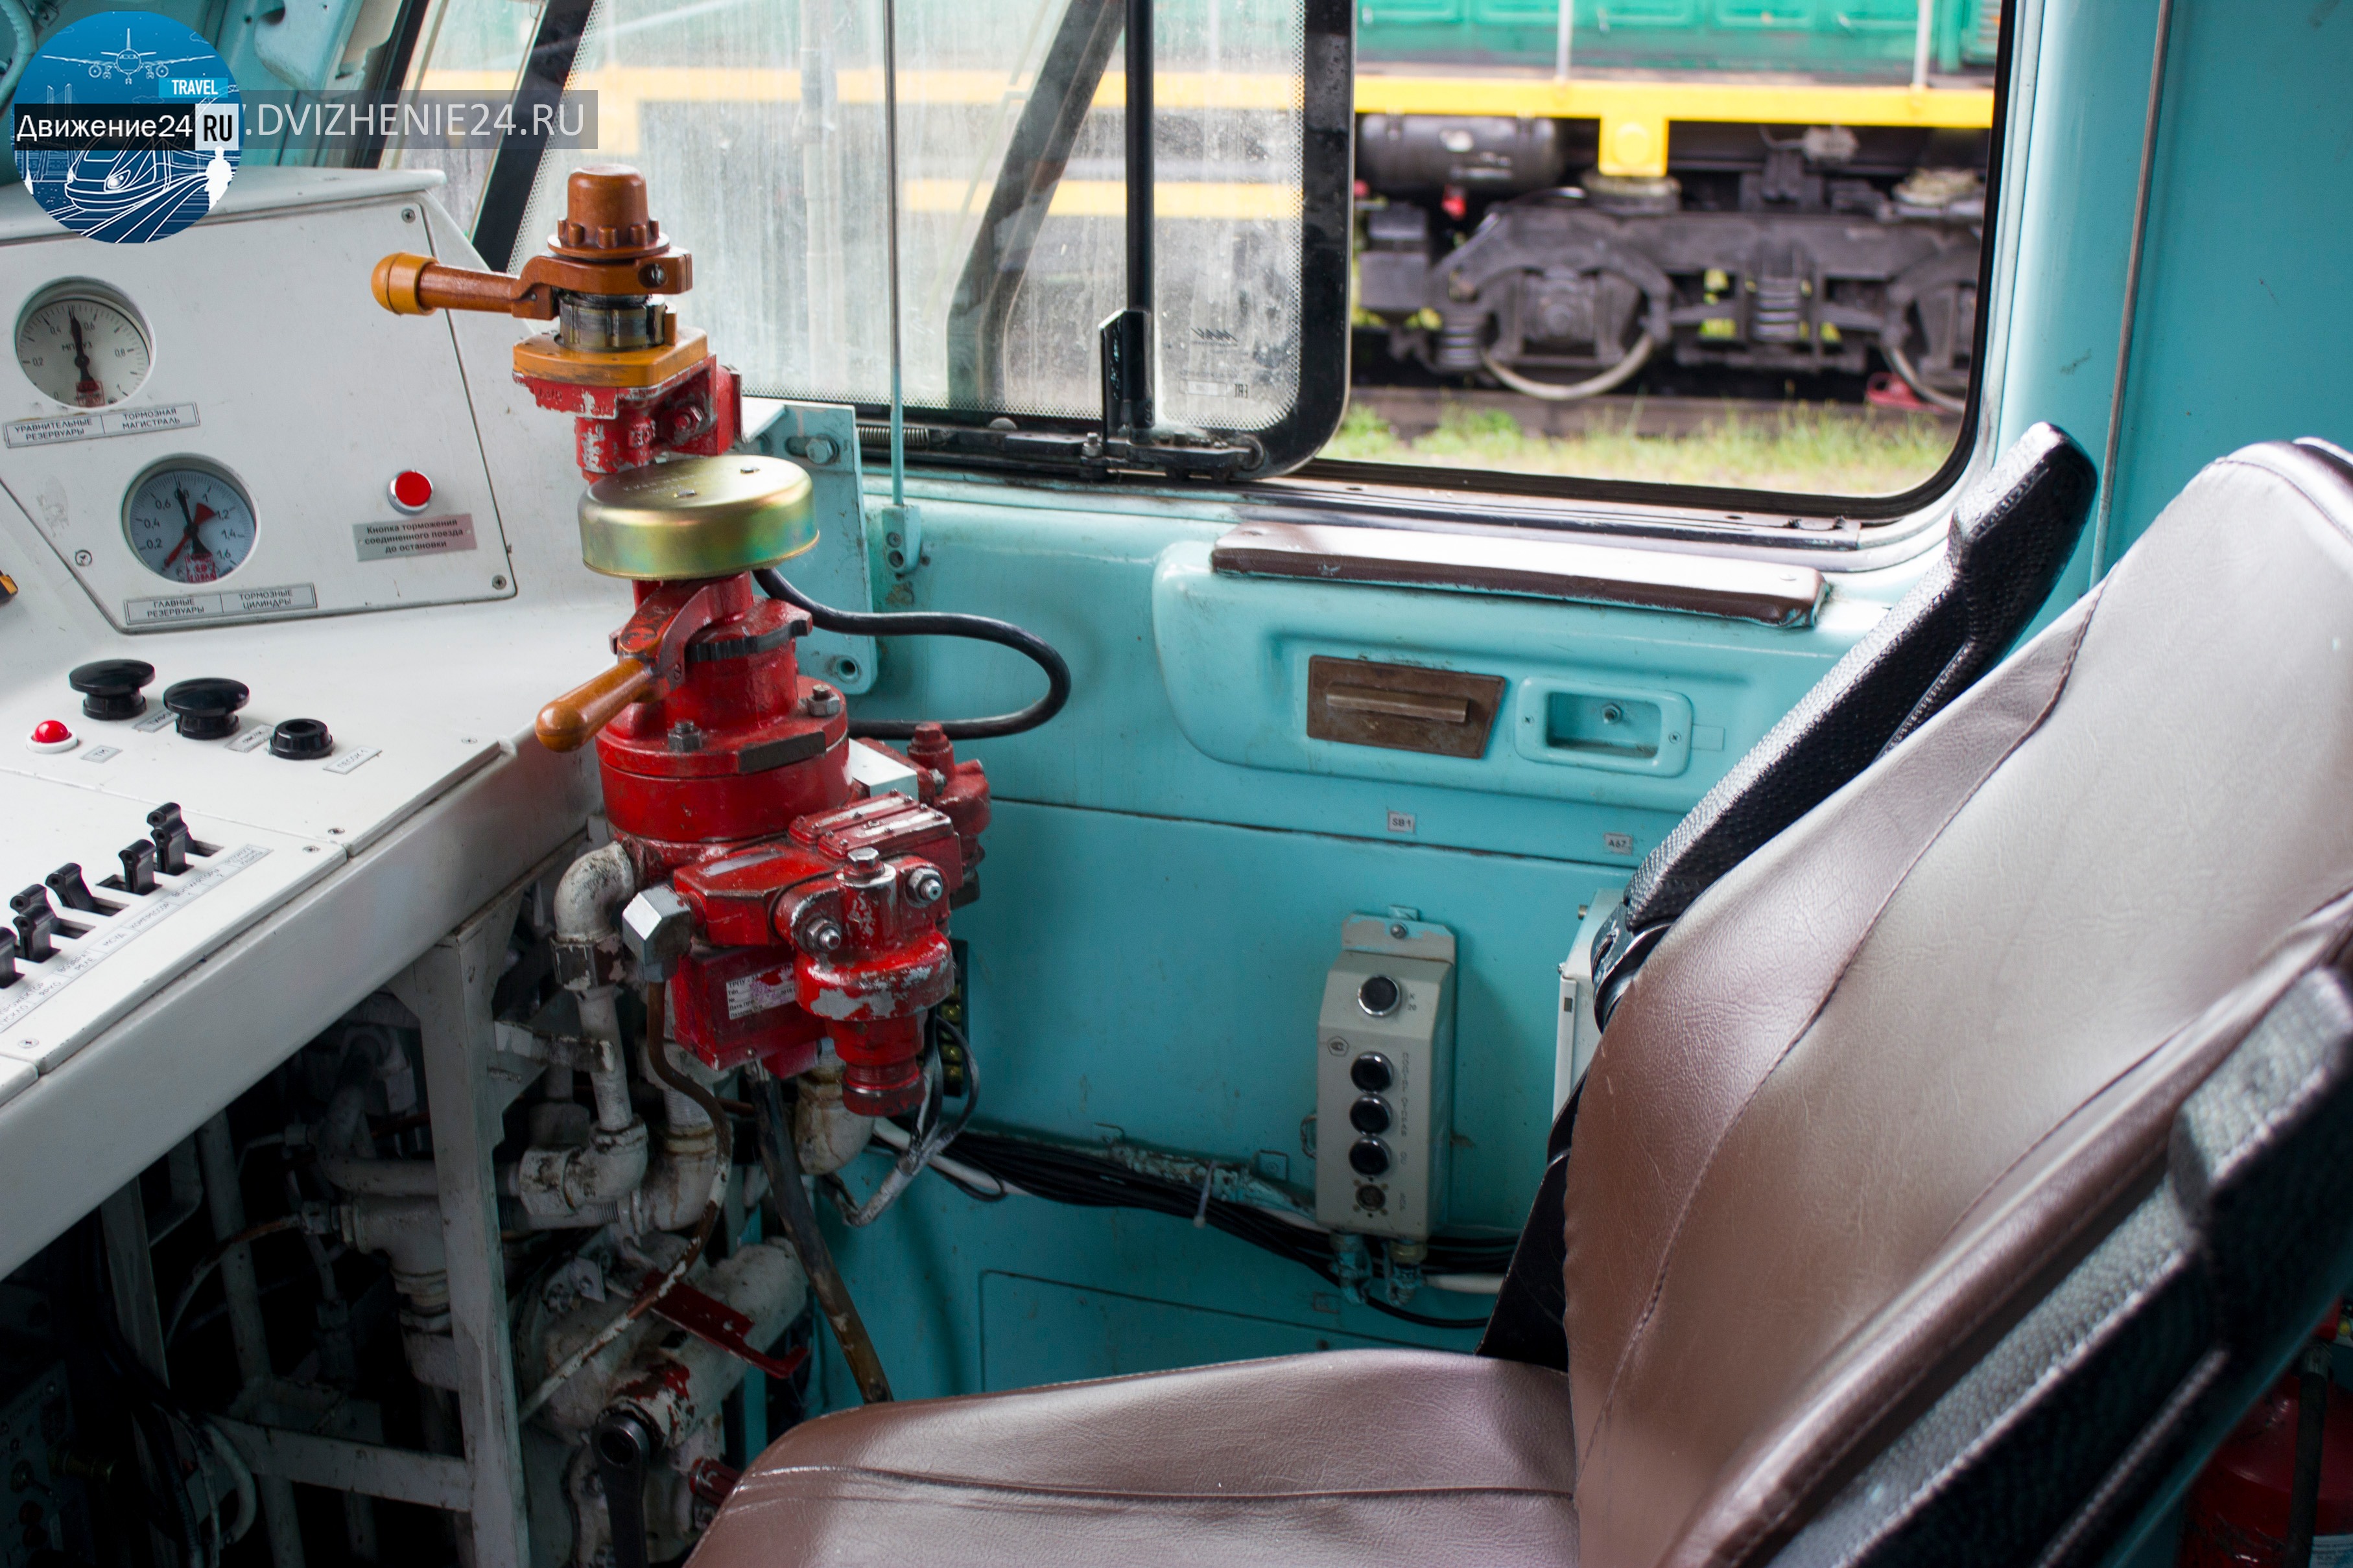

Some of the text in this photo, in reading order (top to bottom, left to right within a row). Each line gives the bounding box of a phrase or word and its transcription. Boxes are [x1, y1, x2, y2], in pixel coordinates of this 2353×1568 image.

[123, 408, 177, 421] ТОРМОЗНАЯ
[15, 418, 93, 432] УРАВНИТЕЛЬНЫЕ
[123, 417, 181, 430] МАГИСТРАЛЬ
[26, 428, 84, 441] РЕЗЕРВУАРЫ
[155, 500, 171, 510] 0,6
[144, 519, 160, 529] 0,4
[367, 519, 458, 534] Кнопка торможения
[221, 530, 236, 539] 1,4
[364, 528, 464, 545] соединенного поезда
[147, 538, 163, 550] 0,2
[399, 541, 447, 552] остановки
[217, 550, 231, 560] 1,6
[239, 590, 292, 601] ТОРМОЗНЫЕ
[154, 598, 195, 608] ГЛАВНЫЕ
[243, 598, 292, 611] ЦИЛИНДРЫ
[147, 606, 205, 618] РЕЗЕРВУАРЫ
